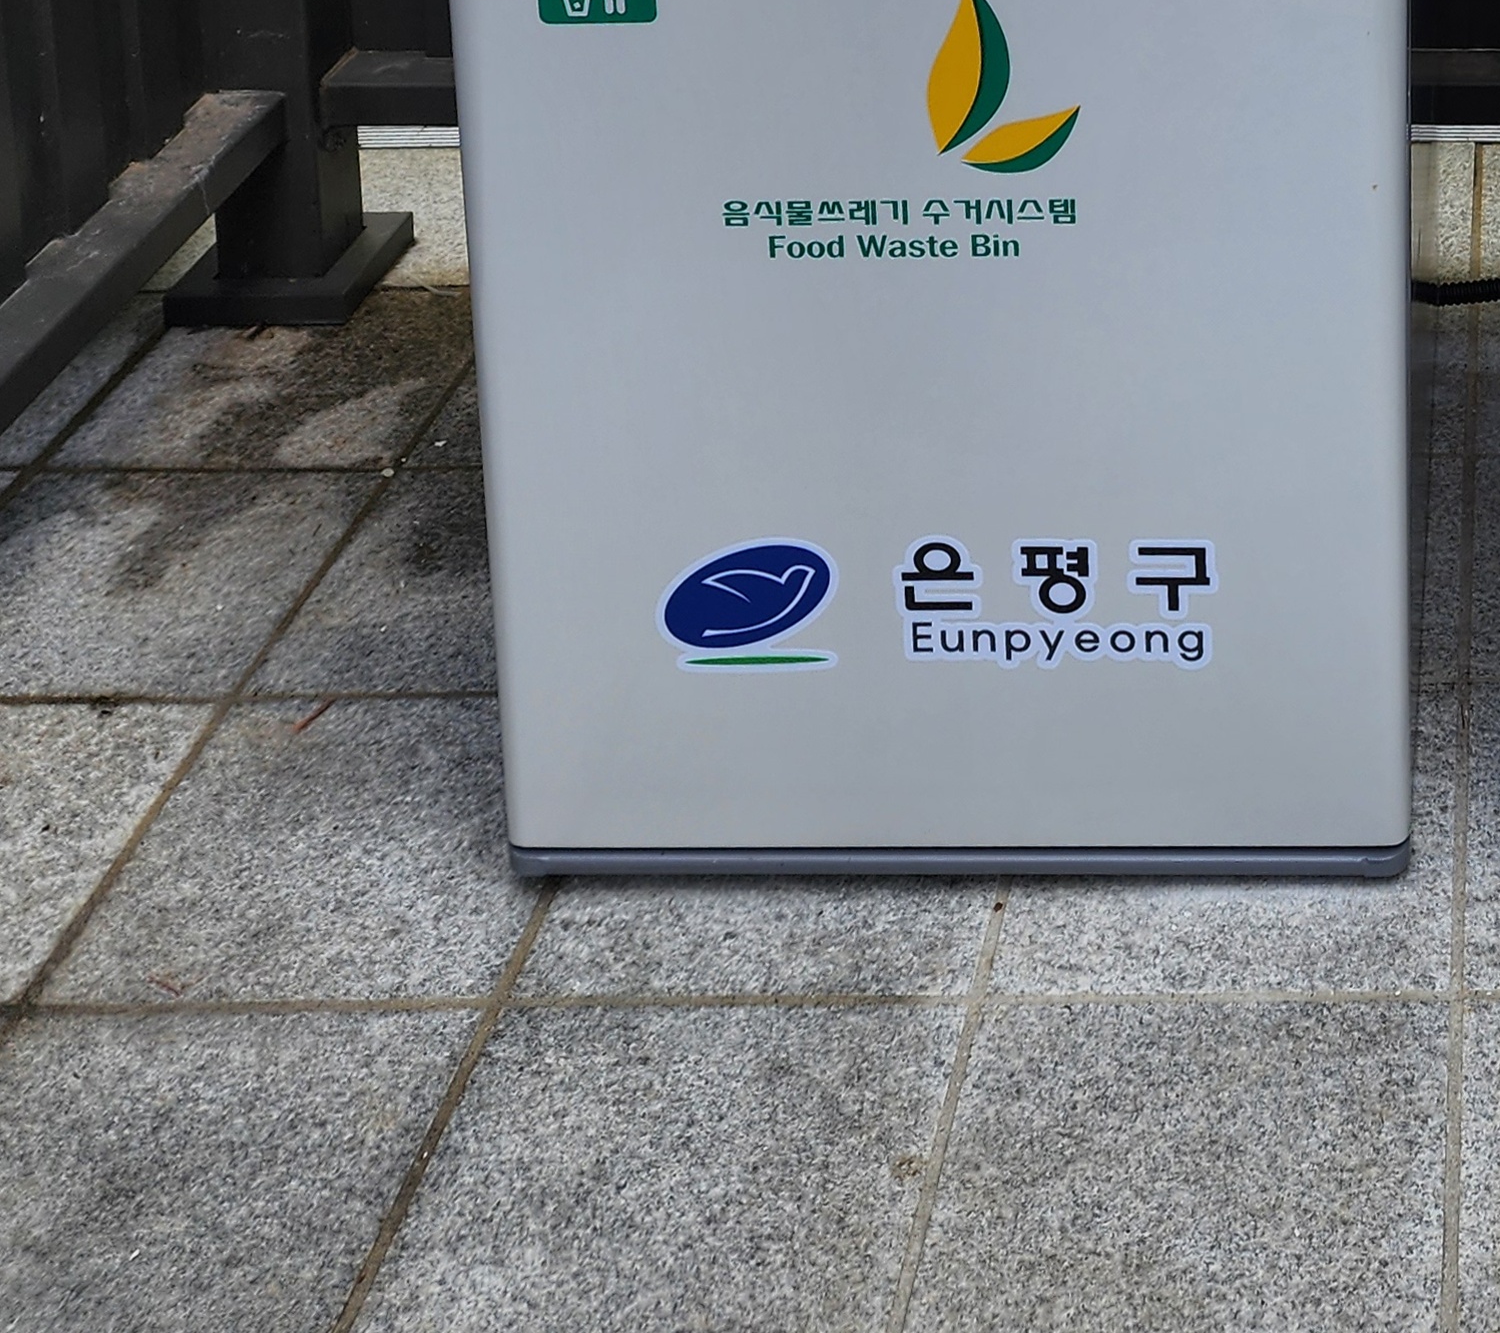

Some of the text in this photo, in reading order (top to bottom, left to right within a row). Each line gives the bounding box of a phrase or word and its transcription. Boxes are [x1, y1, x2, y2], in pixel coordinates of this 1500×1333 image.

[722, 198, 1077, 226] 음식물쓰레기 수거시스템
[768, 234, 1020, 258] Food Waste Bin
[901, 541, 1211, 614] 은평구
[911, 621, 1206, 661] Eunpyeong
